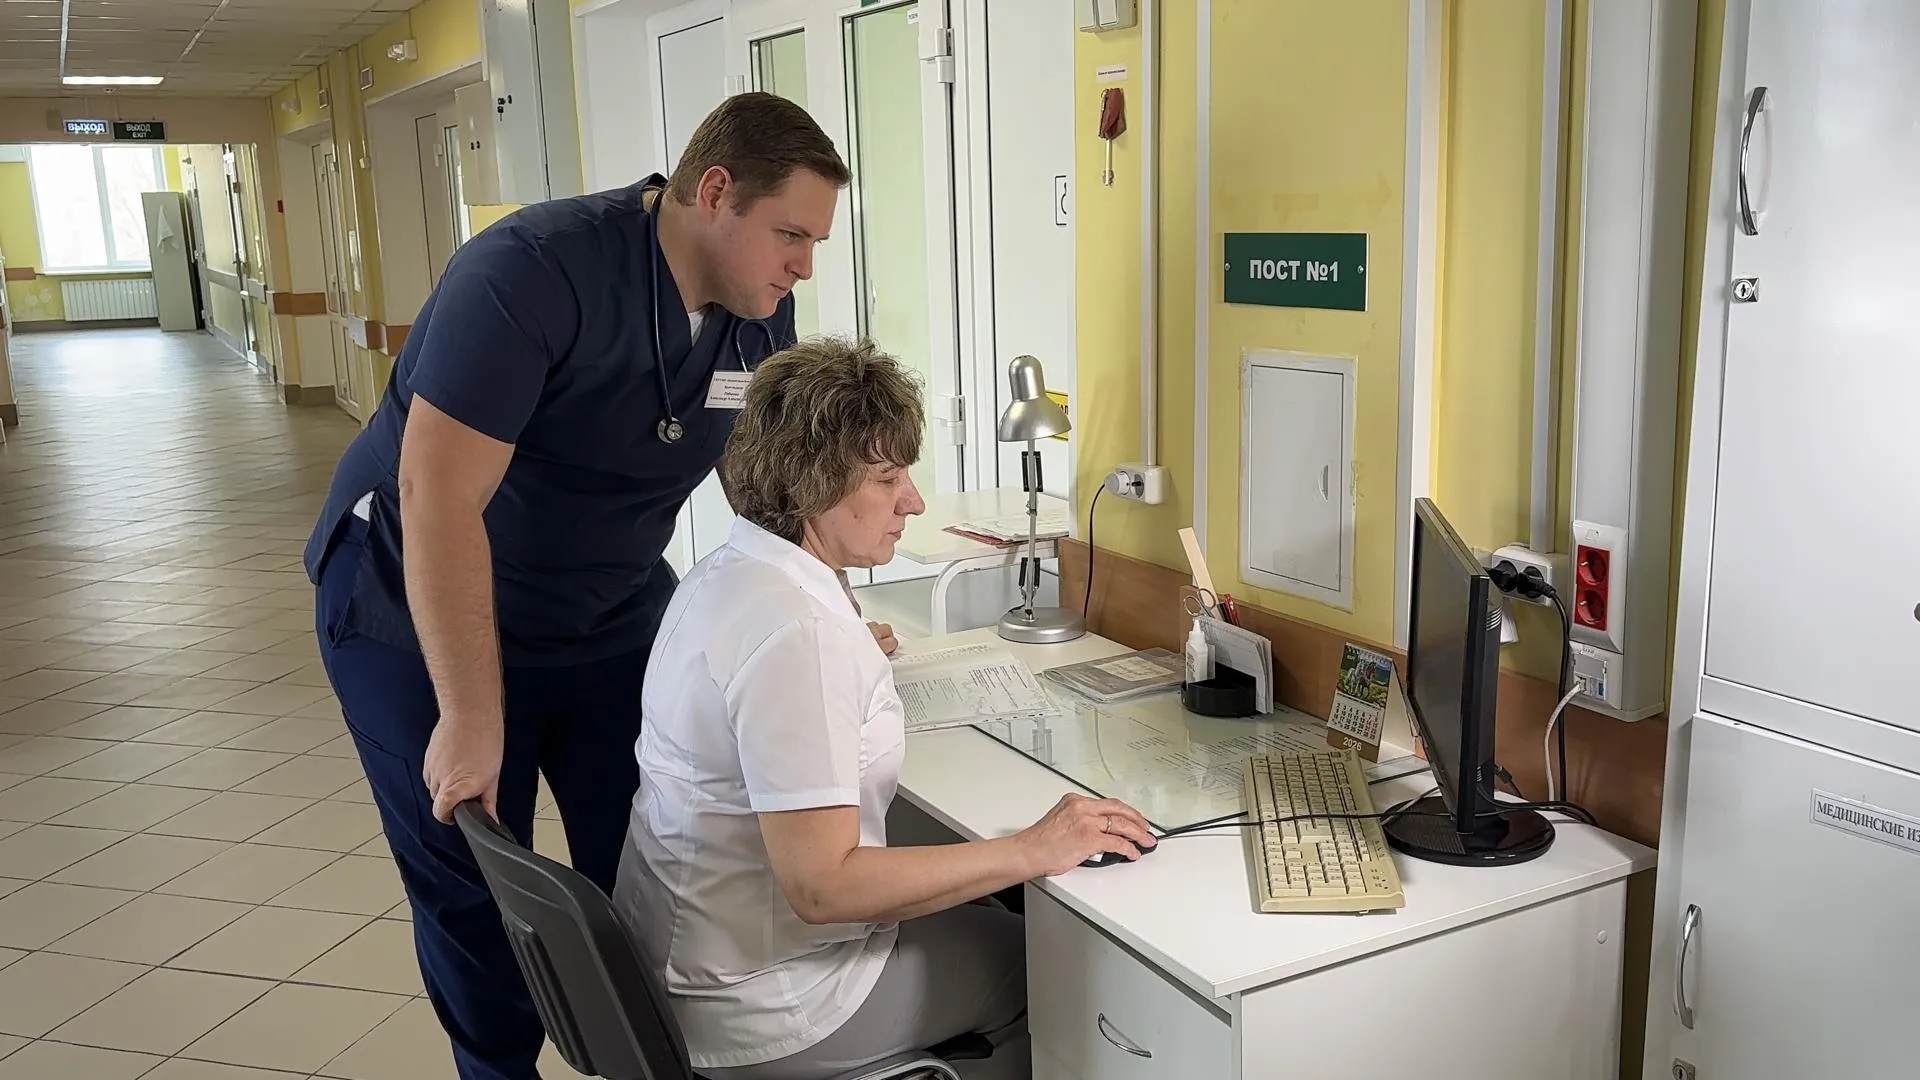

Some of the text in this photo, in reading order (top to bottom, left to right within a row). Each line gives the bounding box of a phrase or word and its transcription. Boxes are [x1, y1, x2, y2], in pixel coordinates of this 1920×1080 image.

[68, 122, 105, 132] ВЫХОД
[126, 124, 151, 132] ВЫХОД
[1250, 260, 1338, 282] ПОСТ №1
[1343, 737, 1362, 751] 2026
[1817, 800, 1905, 838] МЕДИЦИНСКИЕ
